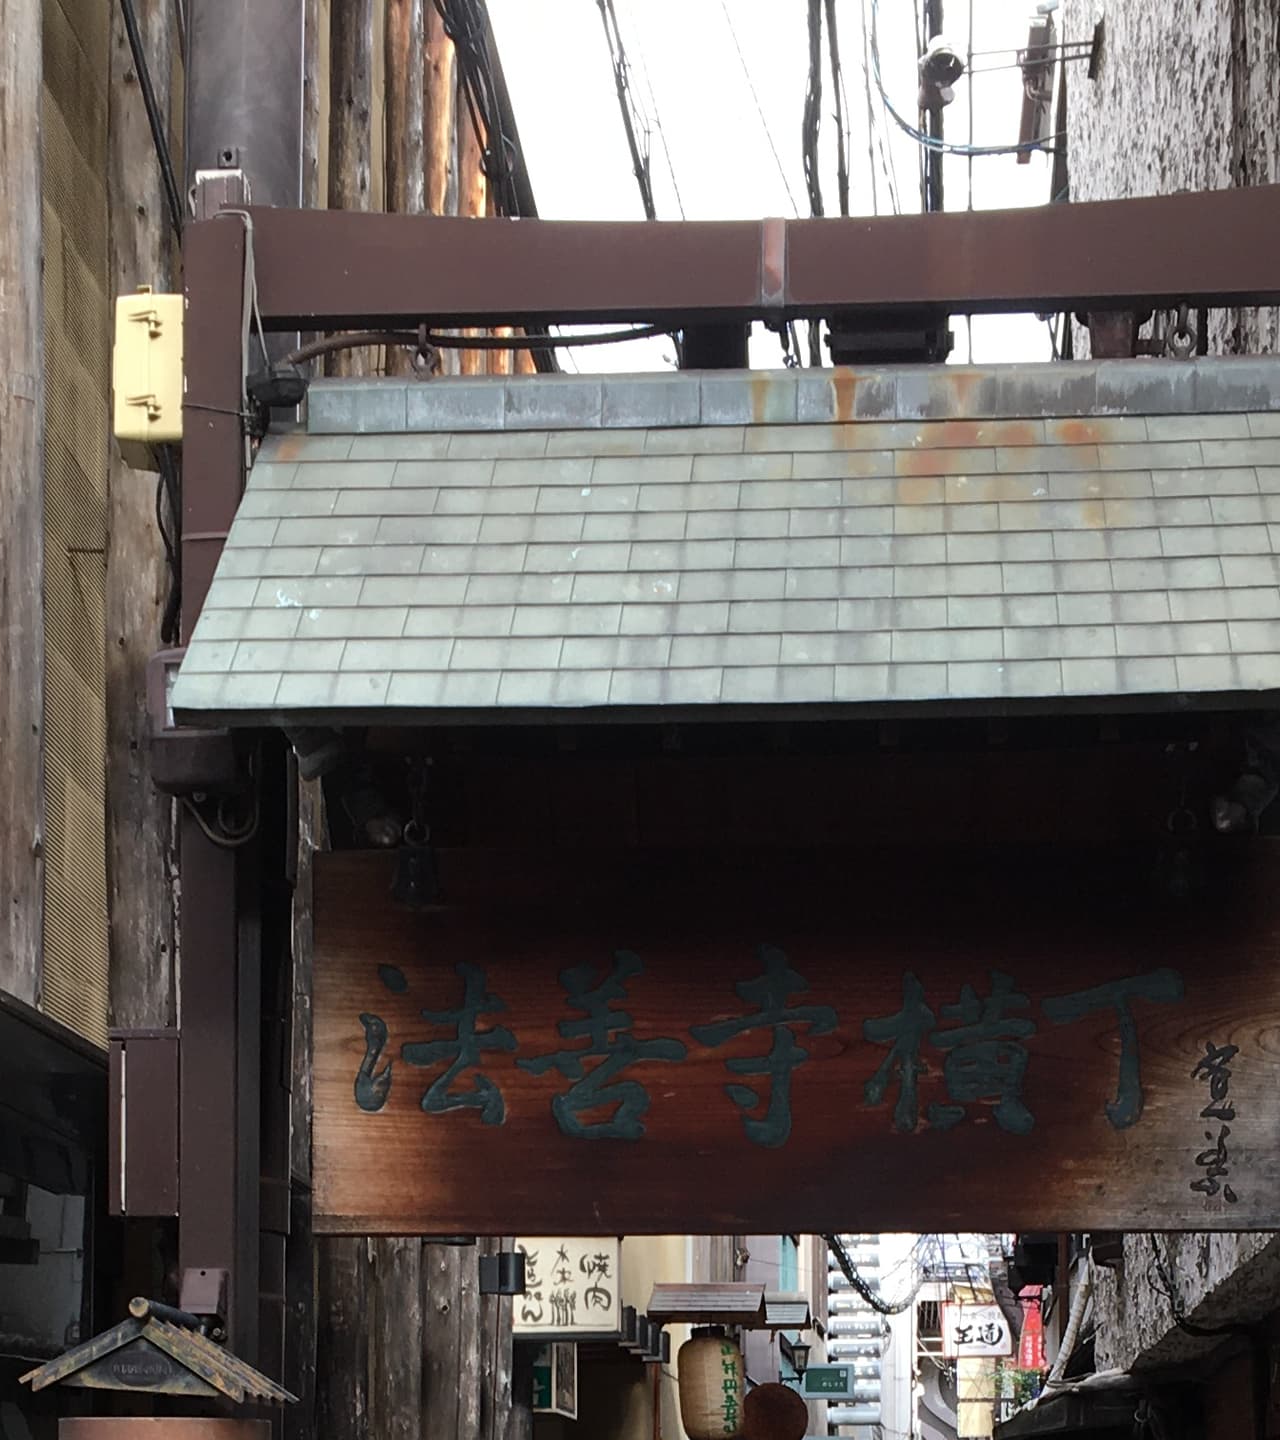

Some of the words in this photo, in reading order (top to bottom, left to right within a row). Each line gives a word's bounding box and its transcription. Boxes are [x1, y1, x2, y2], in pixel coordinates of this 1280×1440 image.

[353, 944, 1184, 1149] 法善寺横丁
[578, 1251, 612, 1312] 焼肉
[953, 1322, 1004, 1346] 王道
